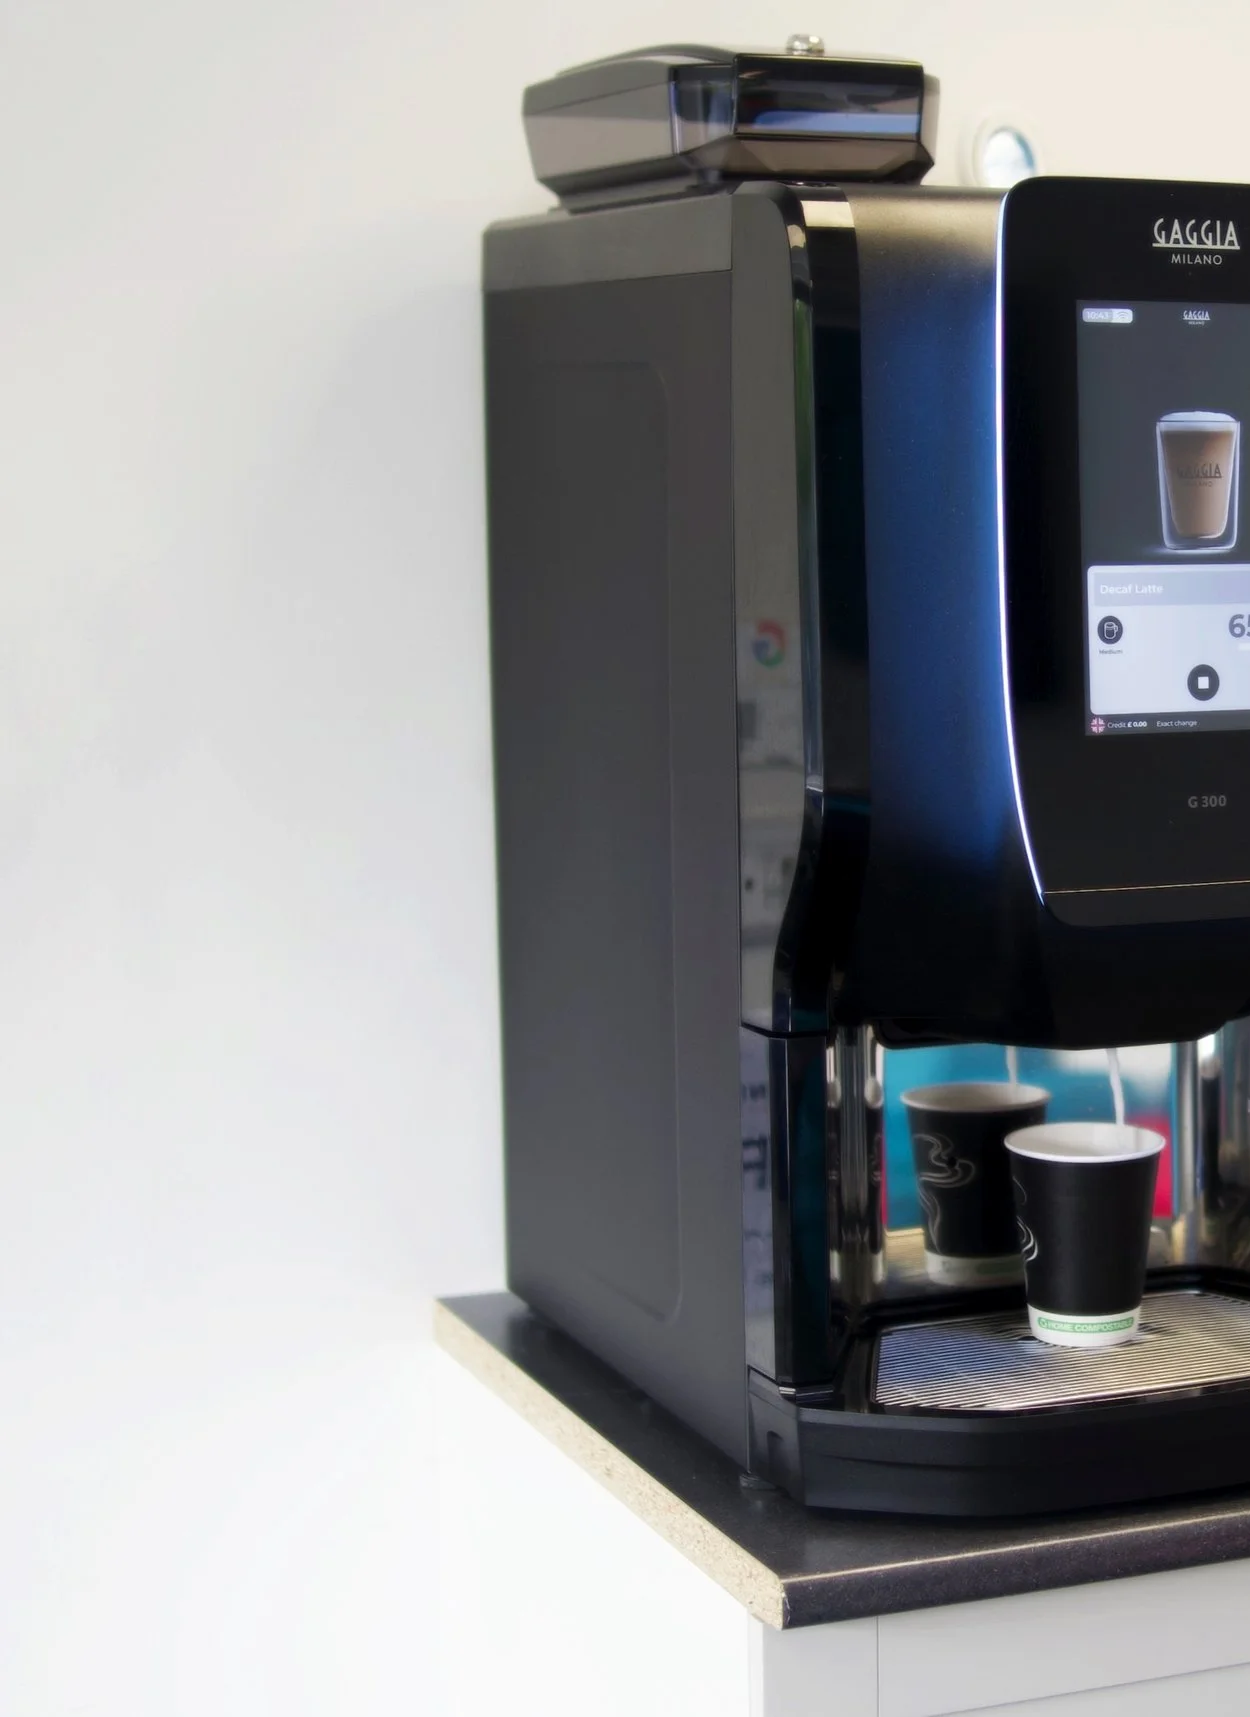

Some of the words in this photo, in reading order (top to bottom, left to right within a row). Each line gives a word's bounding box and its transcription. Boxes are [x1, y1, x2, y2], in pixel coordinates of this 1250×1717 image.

[1152, 218, 1240, 250] GAGGIA
[1171, 254, 1223, 265] MILANO
[1183, 310, 1211, 321] GAGGIA
[1100, 584, 1132, 594] Decaf
[1135, 584, 1164, 594] Latte
[1156, 720, 1174, 728] Exact
[1174, 720, 1198, 728] change
[1188, 795, 1198, 808] G
[1201, 795, 1227, 808] 300
